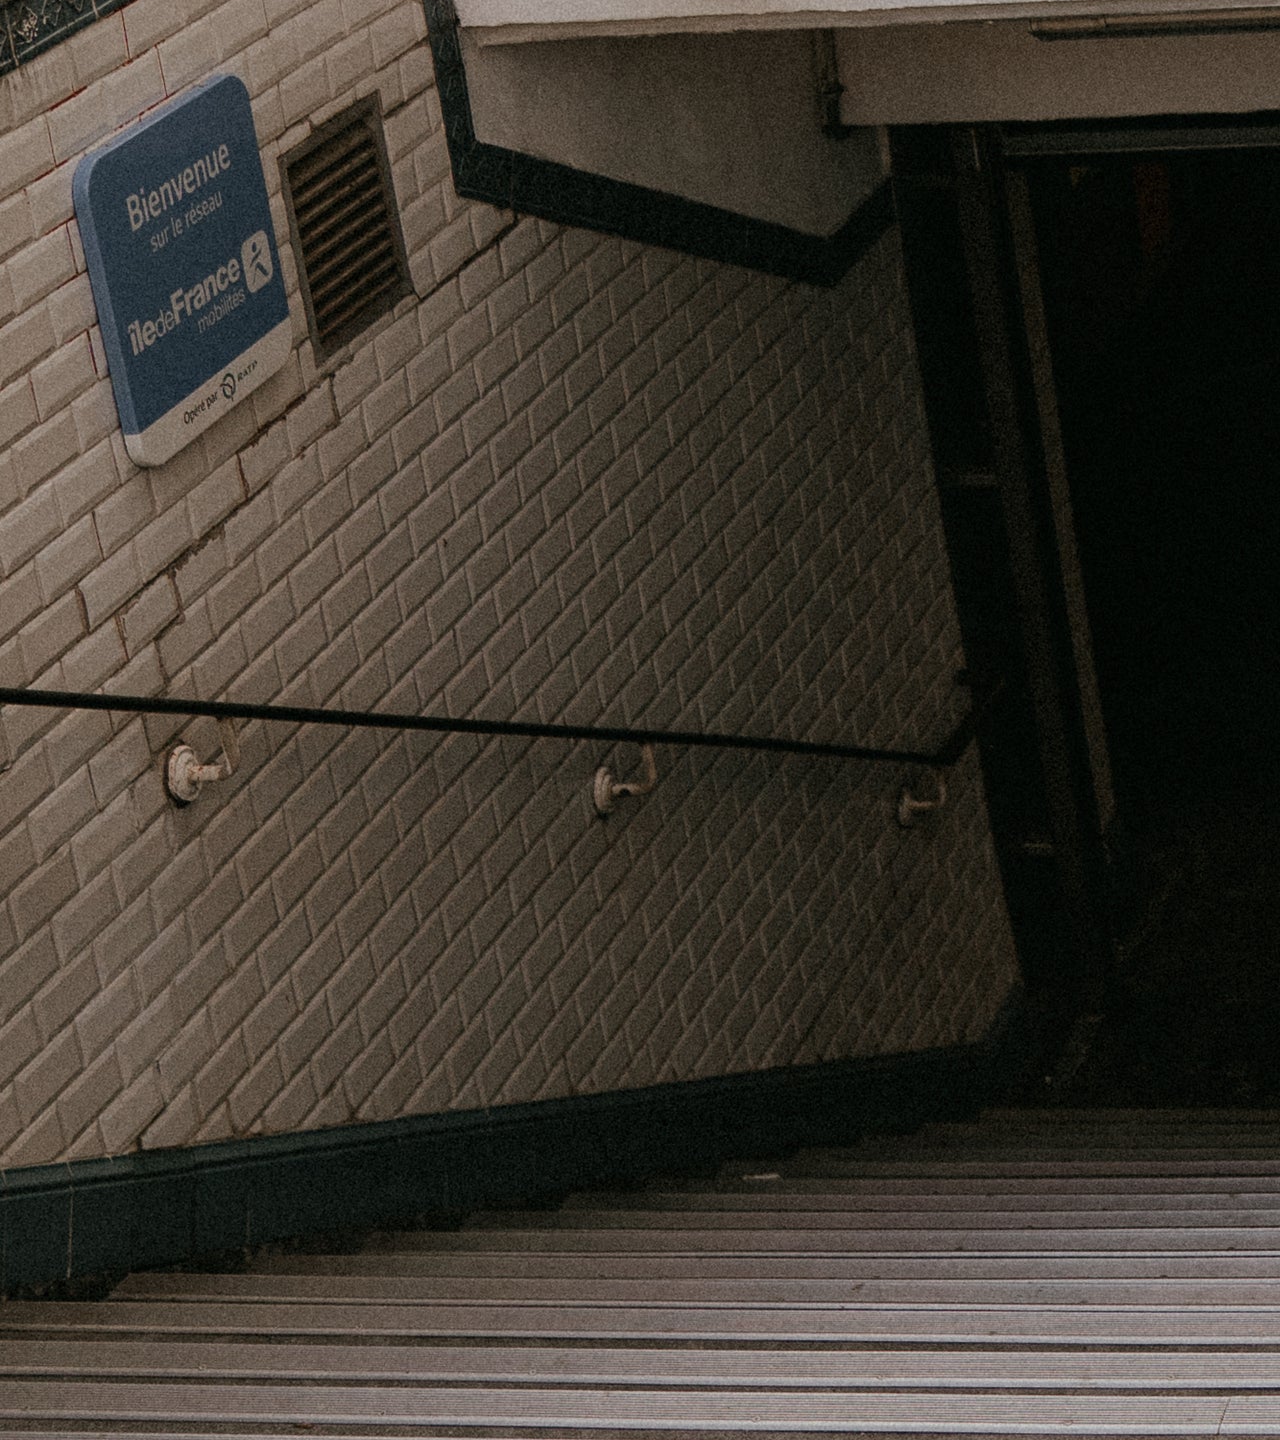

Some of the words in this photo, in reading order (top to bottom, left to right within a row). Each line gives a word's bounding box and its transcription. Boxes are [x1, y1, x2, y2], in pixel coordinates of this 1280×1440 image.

[126, 143, 231, 232] Bienvenue
[150, 226, 169, 253] sur
[171, 217, 184, 238] le
[185, 191, 223, 229] réseau
[196, 288, 246, 334] mobilités
[206, 391, 218, 409] par
[237, 360, 258, 382] RATP
